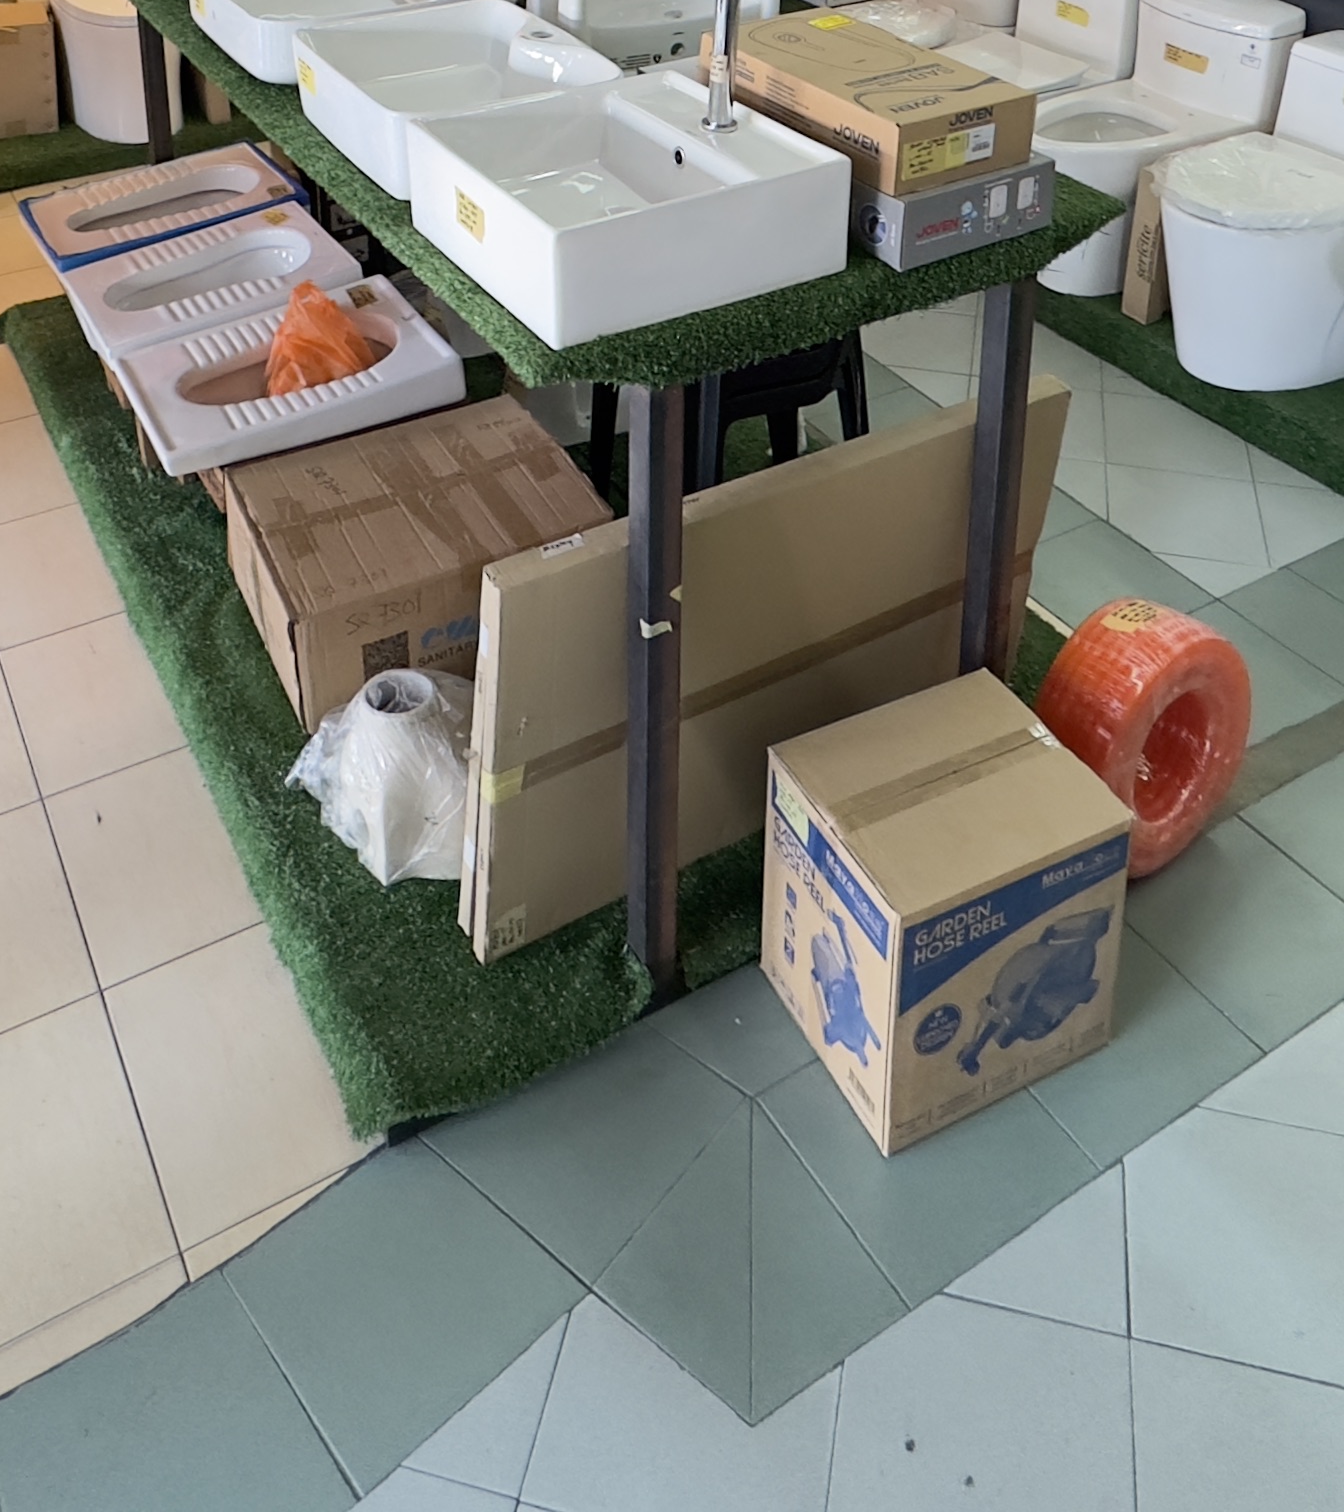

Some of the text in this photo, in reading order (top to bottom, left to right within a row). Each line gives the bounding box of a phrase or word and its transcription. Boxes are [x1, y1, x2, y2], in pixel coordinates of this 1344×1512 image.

[890, 94, 946, 115] JOVEN
[948, 105, 994, 129] JOVEN
[833, 123, 880, 155] JOVEN
[916, 217, 959, 238] JOVEN
[773, 816, 816, 880] GARDEN
[773, 830, 828, 914] HOSE REEL
[1041, 861, 1084, 889] Maya
[913, 911, 1007, 966] HOSE REEL
[914, 900, 991, 947] GARDEN
